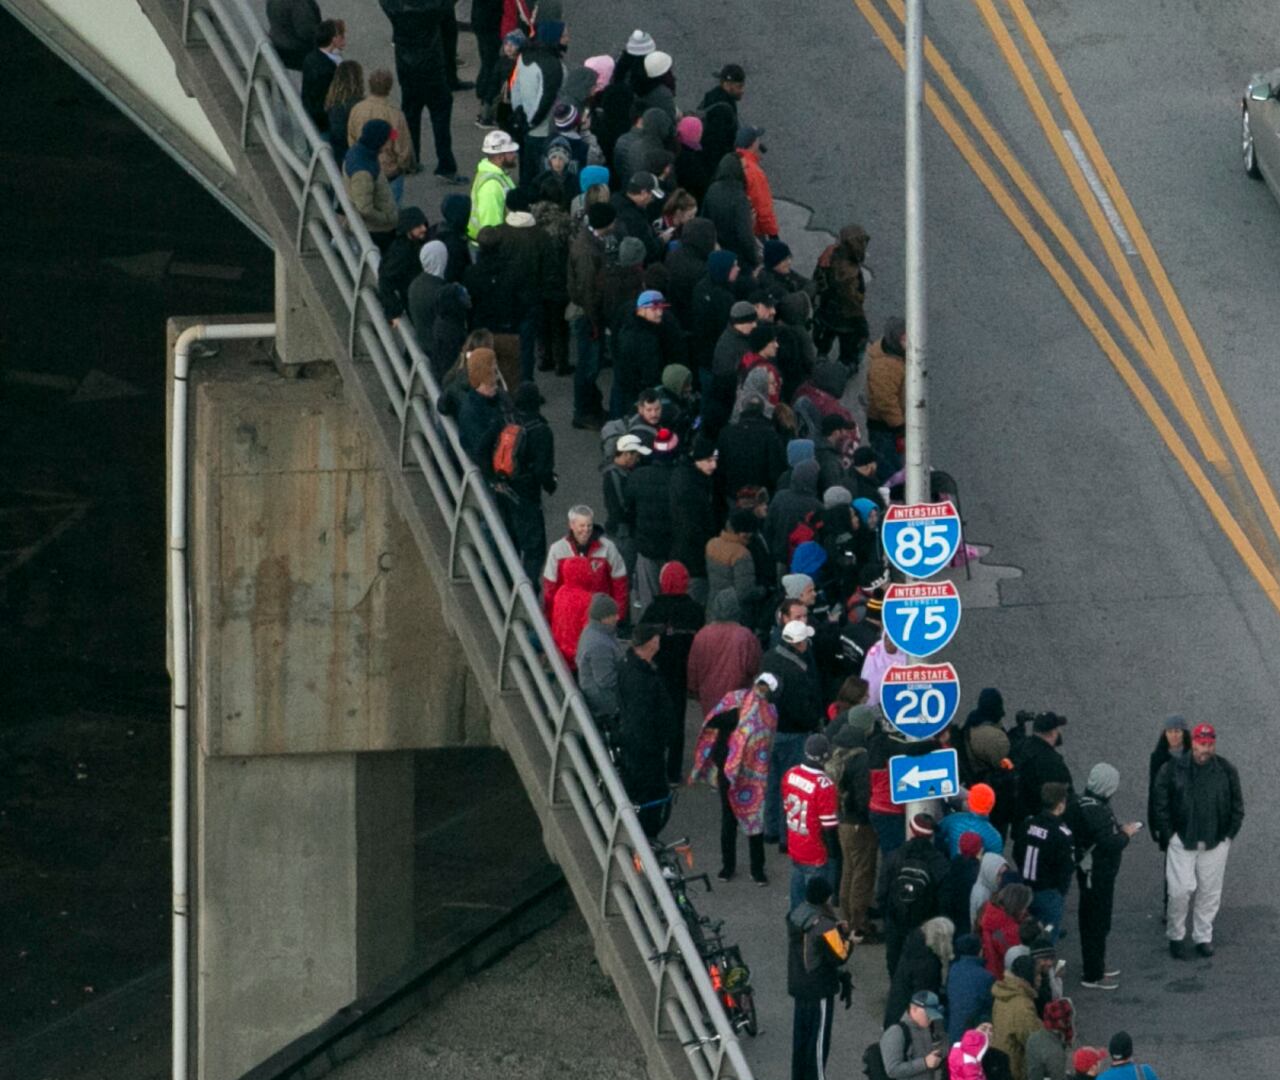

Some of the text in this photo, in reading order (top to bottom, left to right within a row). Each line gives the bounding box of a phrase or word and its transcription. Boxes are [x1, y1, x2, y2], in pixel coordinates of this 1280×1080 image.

[893, 506, 948, 518] INTERSTATE
[907, 519, 936, 527] GEORGIA
[895, 524, 951, 567] 85
[894, 585, 948, 598] INTERSTATE
[904, 598, 939, 606] GEORGIA
[895, 605, 947, 642] 75
[890, 669, 949, 681] INTERSTATE
[895, 689, 946, 725] 20
[784, 793, 809, 835] 21
[1026, 824, 1049, 841] JONES
[1022, 845, 1040, 881] 11
